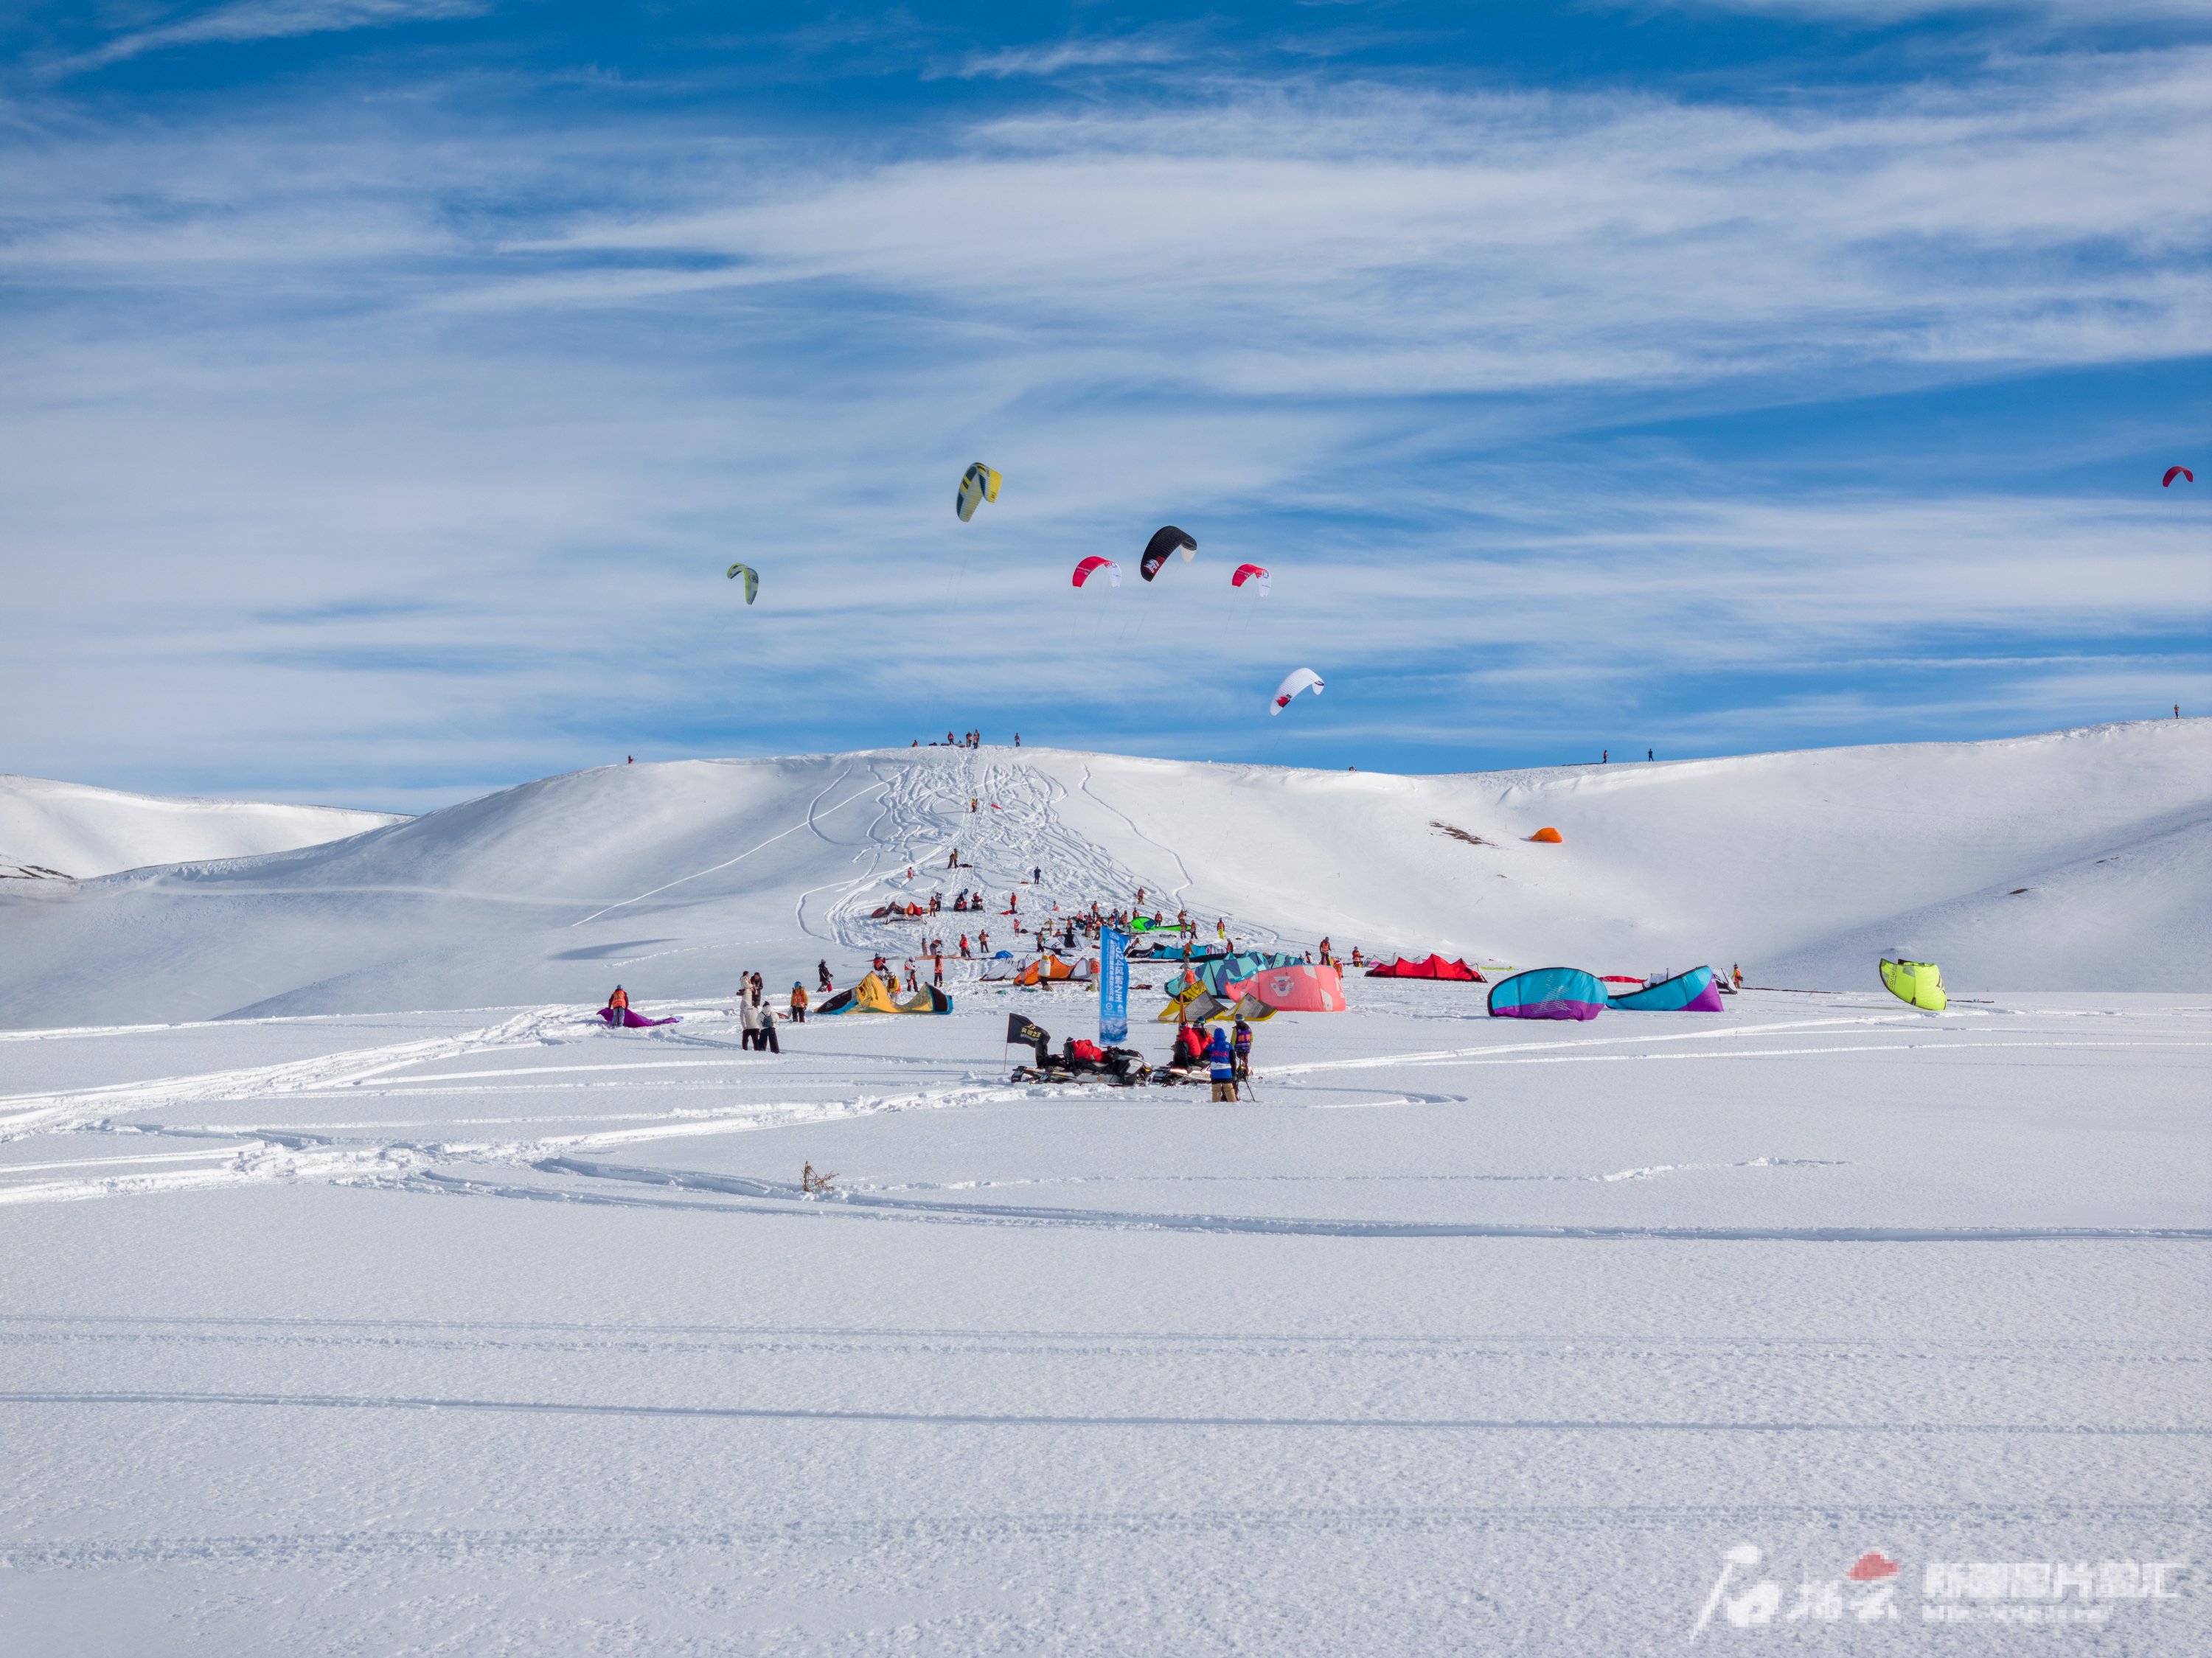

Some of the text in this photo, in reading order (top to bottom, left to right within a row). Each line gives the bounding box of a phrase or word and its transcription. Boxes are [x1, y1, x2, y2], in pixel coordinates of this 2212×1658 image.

[1114, 941, 1124, 1003] 2024风雪之王
[1020, 1027, 1042, 1038] 风雪之王
